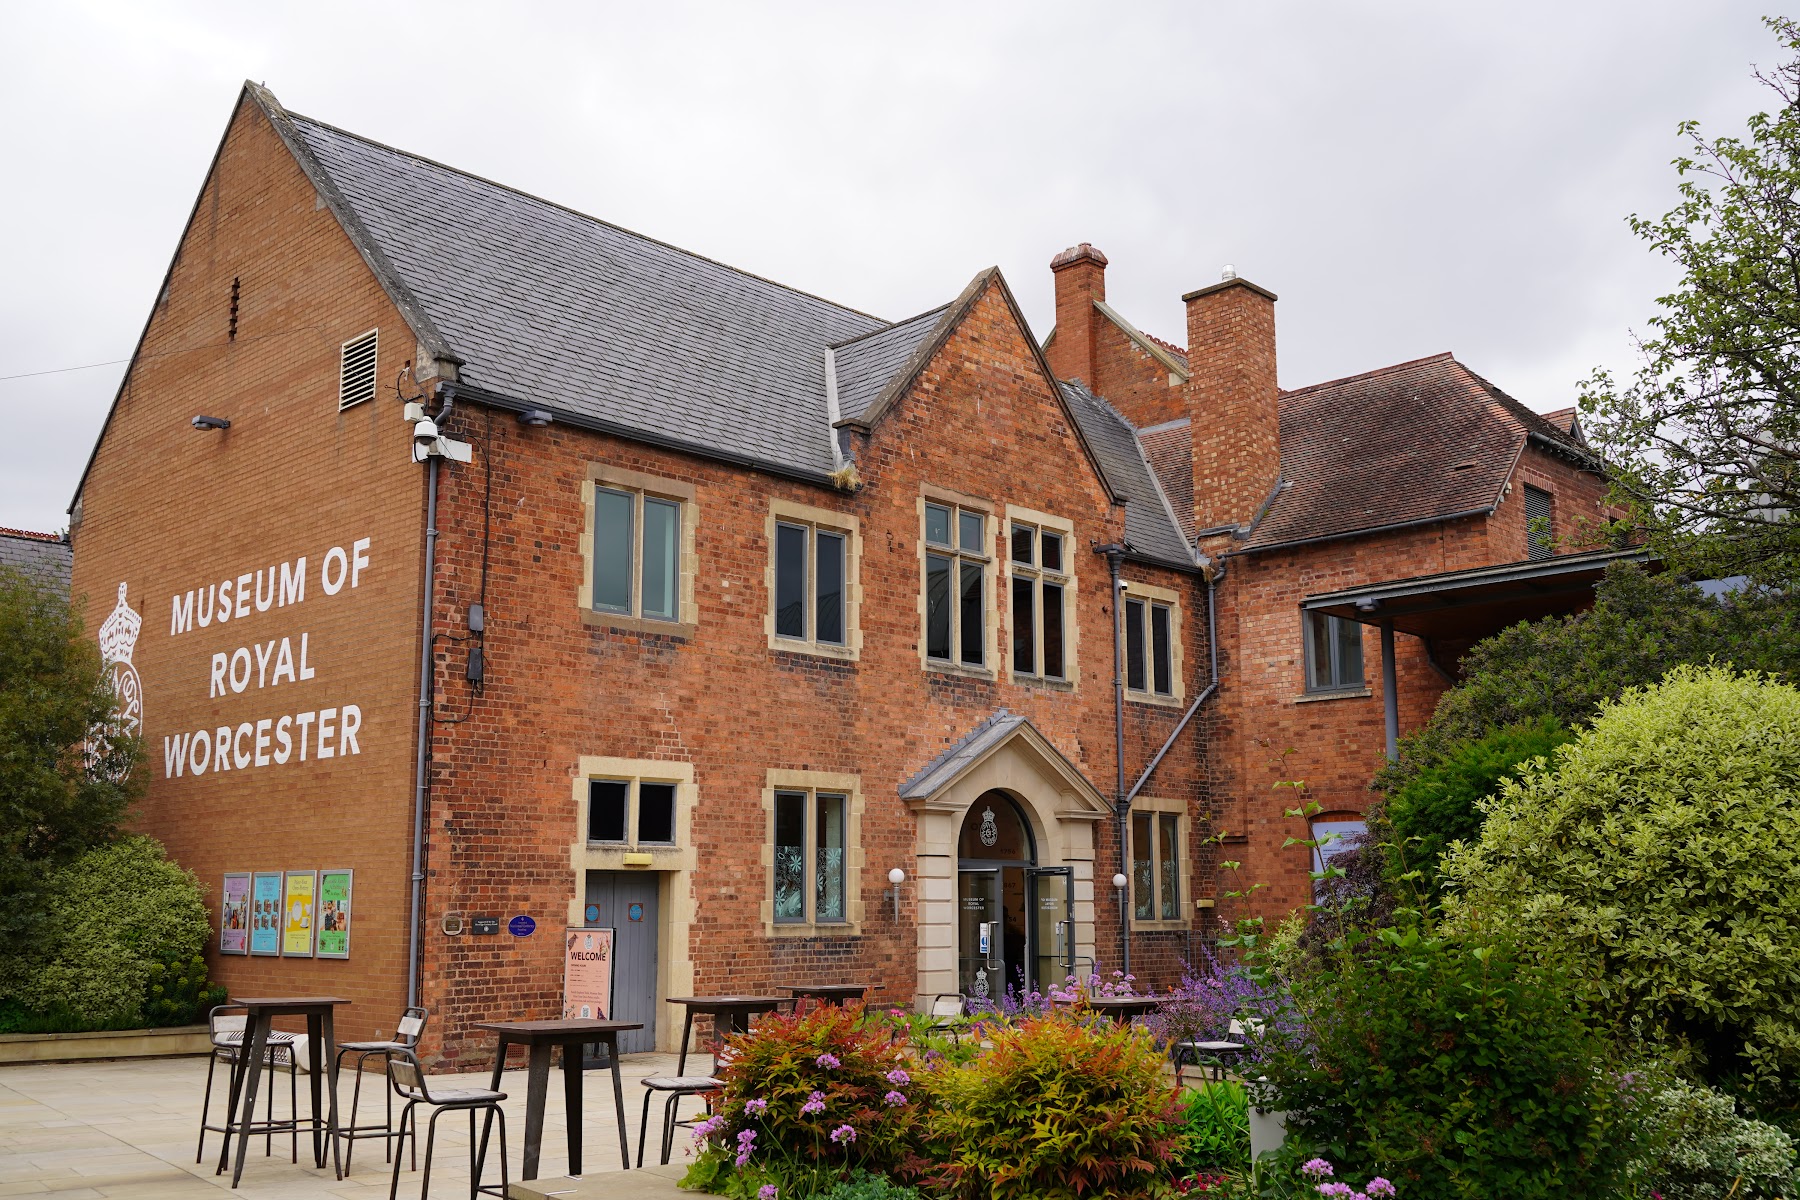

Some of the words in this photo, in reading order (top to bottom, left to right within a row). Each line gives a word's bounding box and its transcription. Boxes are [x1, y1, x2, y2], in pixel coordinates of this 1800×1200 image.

[171, 557, 307, 636] MUSEUM
[321, 537, 371, 596] OF
[210, 632, 315, 699] ROYAL
[163, 704, 362, 779] WORCESTER
[570, 951, 606, 962] WELCOME
